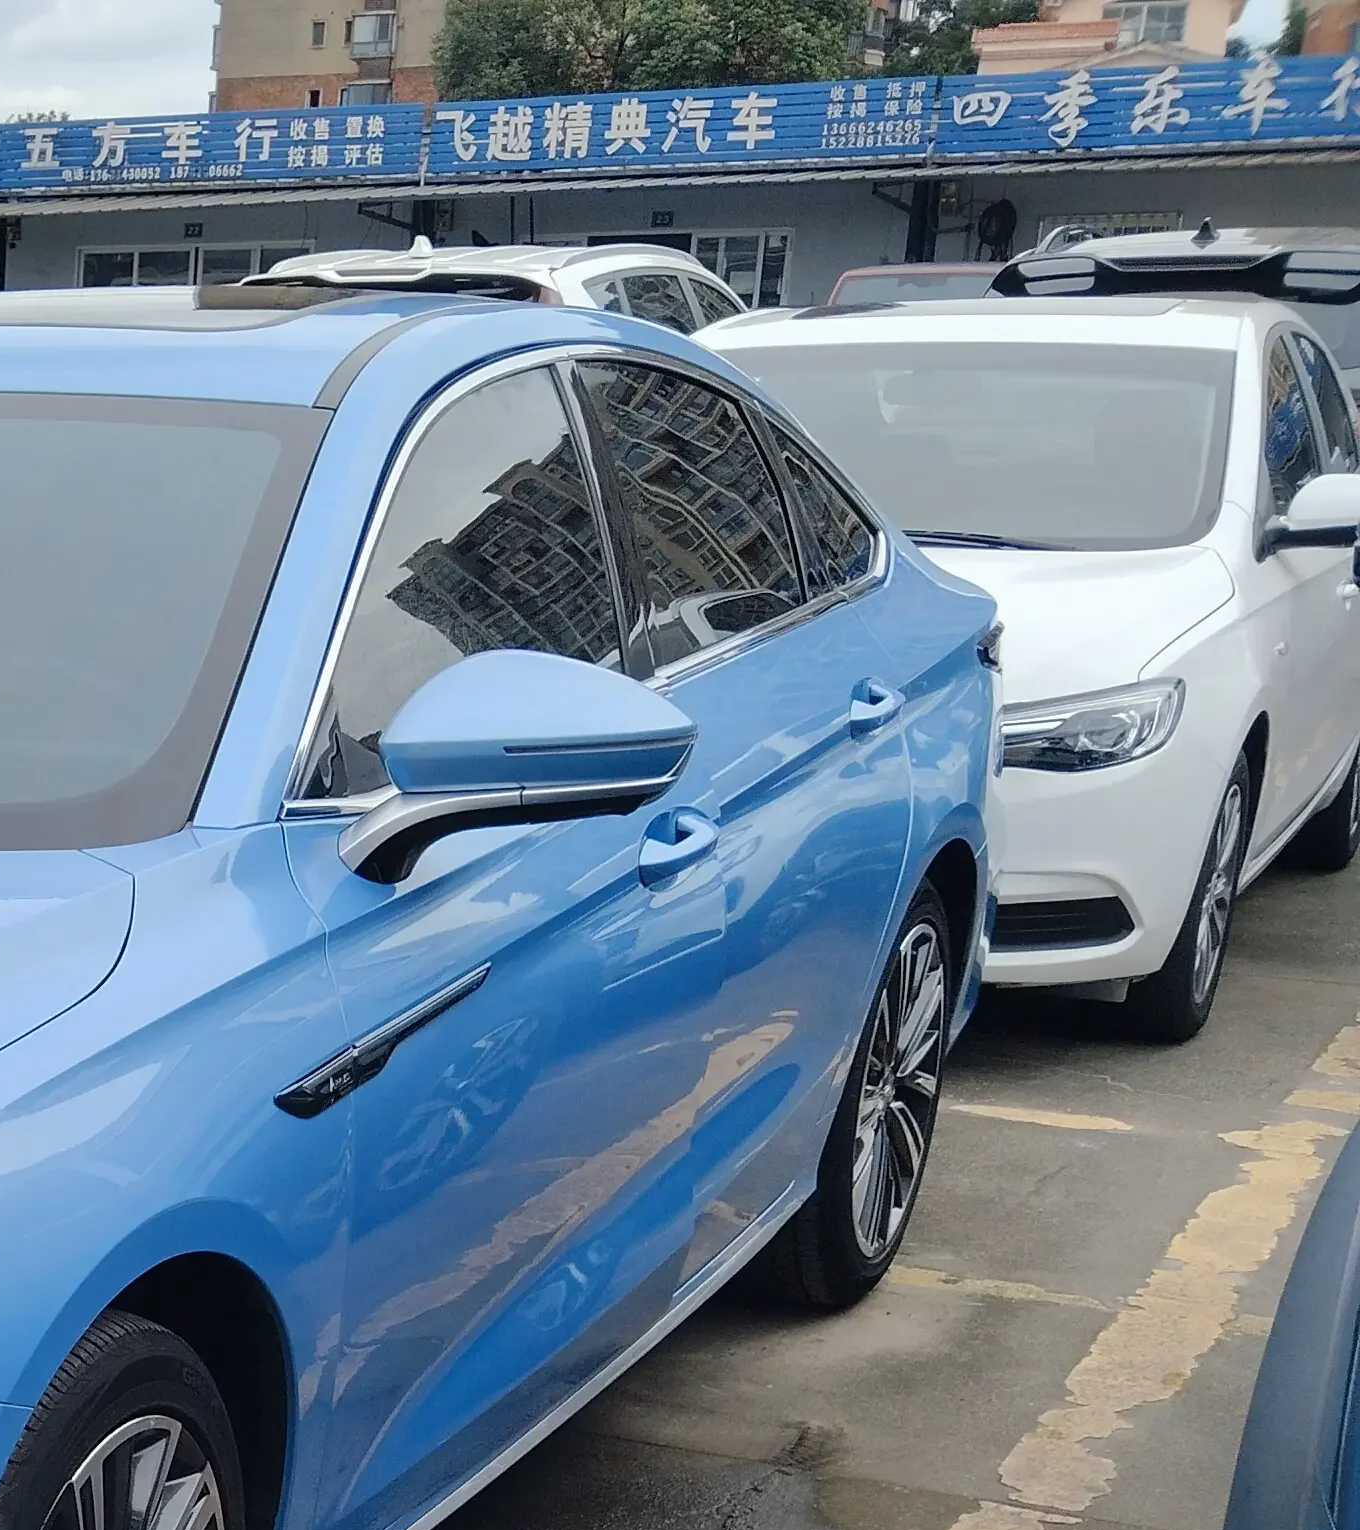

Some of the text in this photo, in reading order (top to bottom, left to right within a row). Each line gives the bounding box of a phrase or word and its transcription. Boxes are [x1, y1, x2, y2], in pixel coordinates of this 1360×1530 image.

[289, 115, 385, 141] 收售 置换
[436, 91, 778, 161] 飞越精典汽车
[822, 119, 922, 136] 13666246265
[20, 118, 278, 169] 五方车行
[287, 143, 384, 168] 按揭 评估
[169, 164, 243, 180] 18706662
